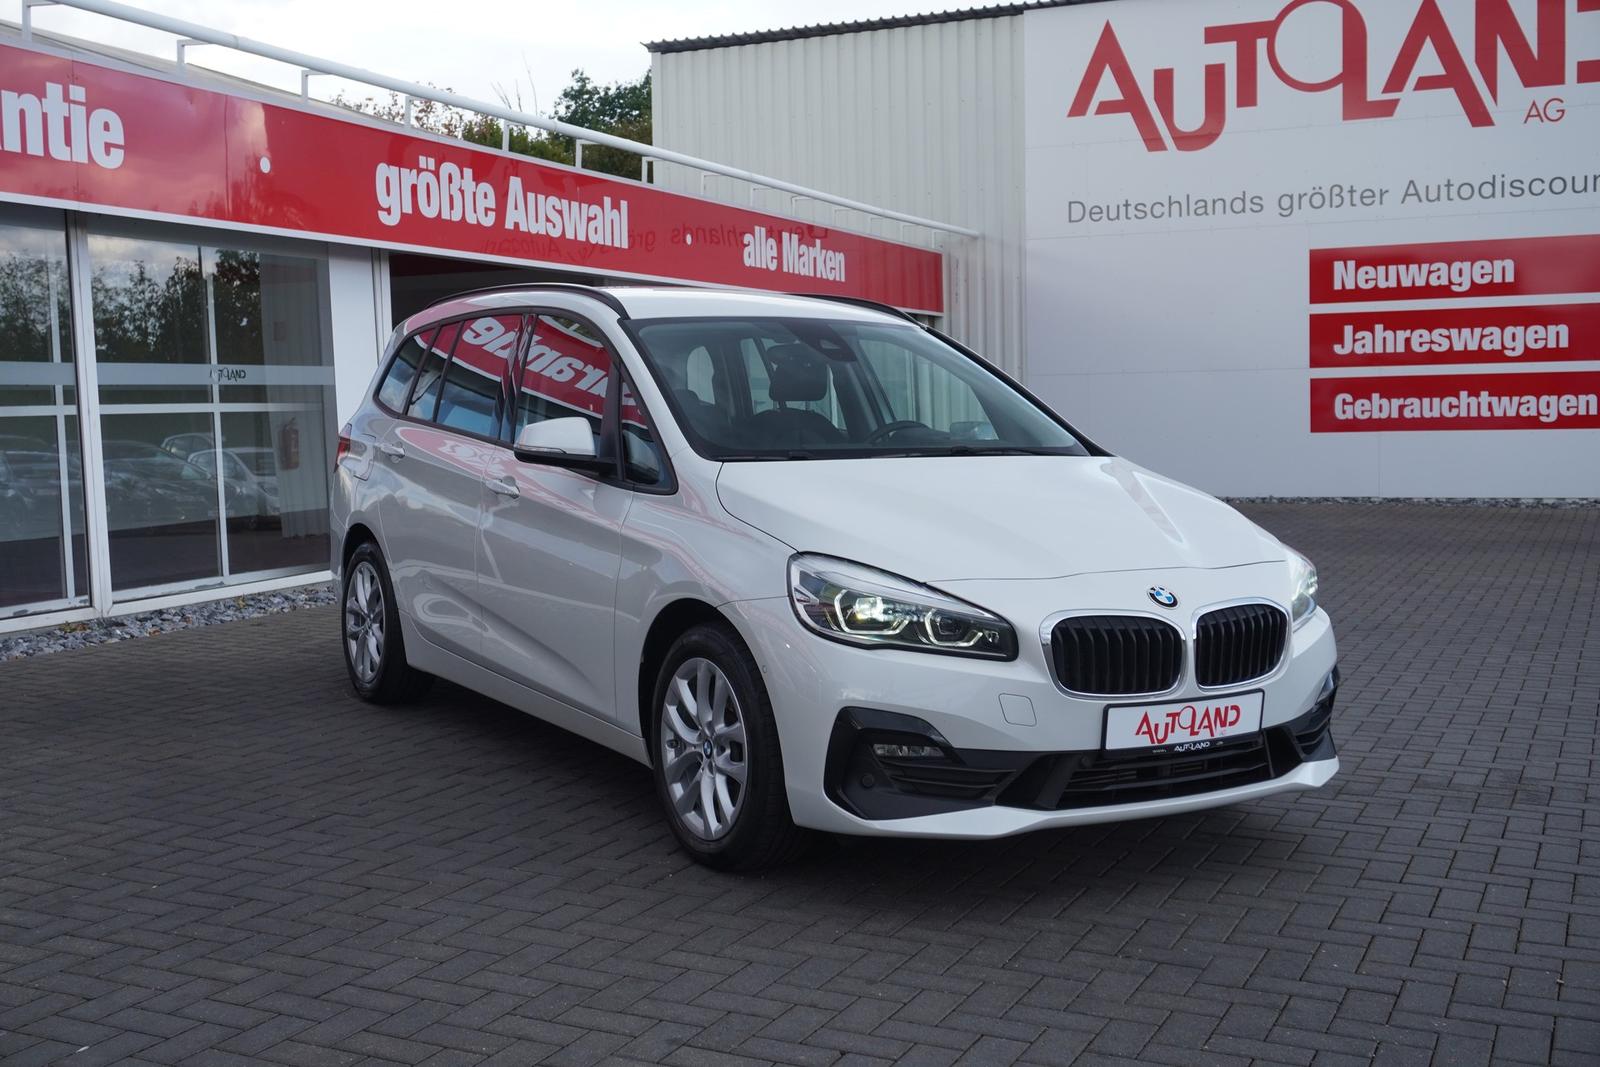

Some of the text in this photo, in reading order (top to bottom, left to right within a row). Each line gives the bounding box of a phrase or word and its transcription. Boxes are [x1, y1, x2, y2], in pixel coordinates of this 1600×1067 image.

[0, 81, 125, 170] ntie
[1523, 97, 1566, 124] AG
[376, 156, 496, 227] größte
[505, 176, 629, 249] Auswahl
[1067, 190, 1265, 224] Deutschlands
[1277, 184, 1390, 218] größter
[743, 225, 846, 282] alle Marken
[1333, 257, 1516, 291] Neuwagen
[1333, 322, 1570, 356] Jahreswagen
[1333, 390, 1598, 422] Gebrauchtwagen
[1135, 704, 1241, 745] AUTOLAND
[1174, 741, 1211, 752] AUTOLAND
